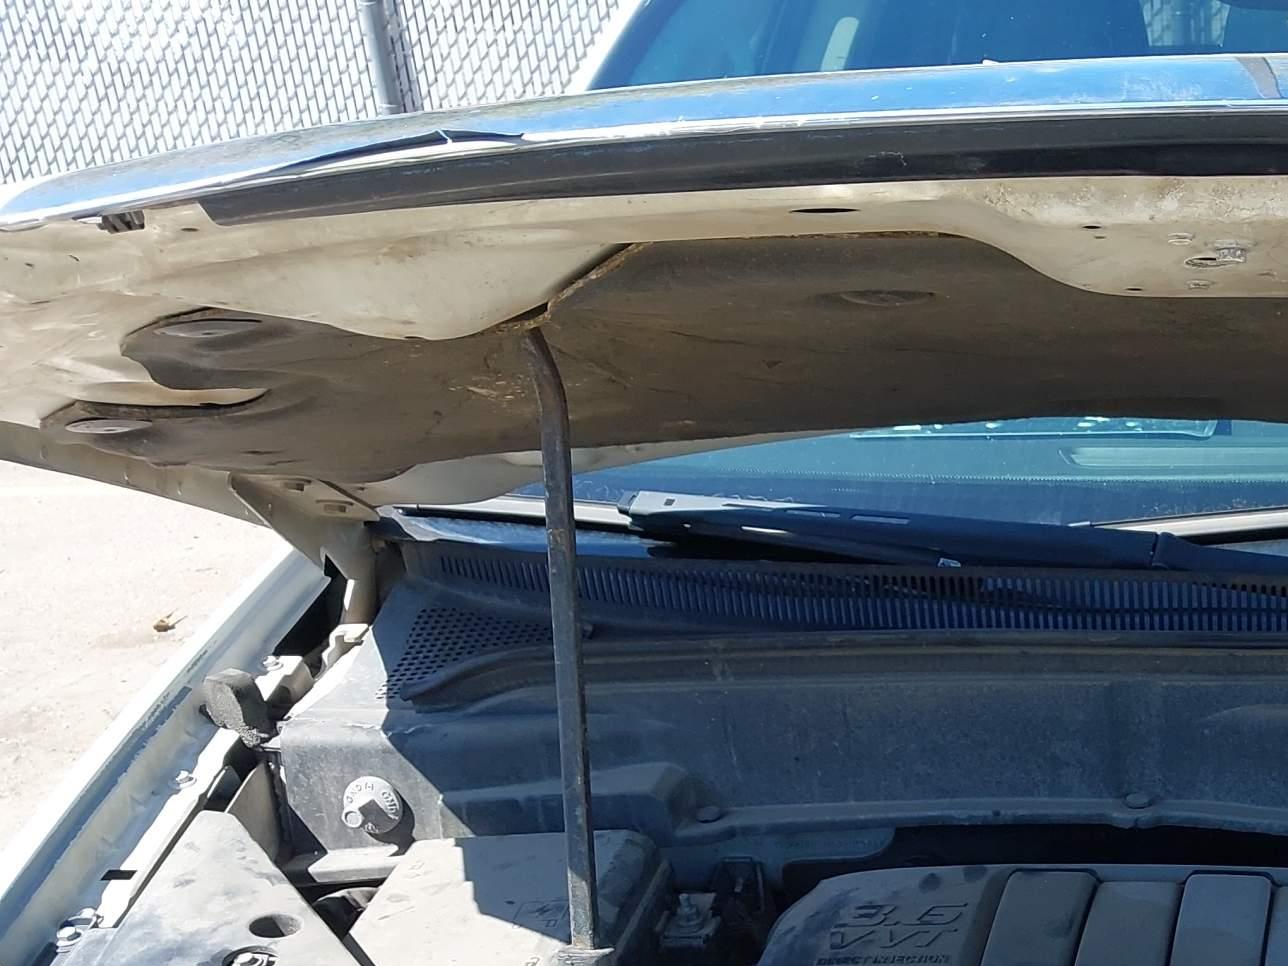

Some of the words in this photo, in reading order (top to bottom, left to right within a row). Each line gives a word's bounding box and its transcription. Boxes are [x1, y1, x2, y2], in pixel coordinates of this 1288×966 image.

[832, 902, 969, 929] 3.6
[829, 928, 959, 950] VVT
[816, 955, 868, 966] DIRECT
[871, 954, 950, 966] INJECTION
